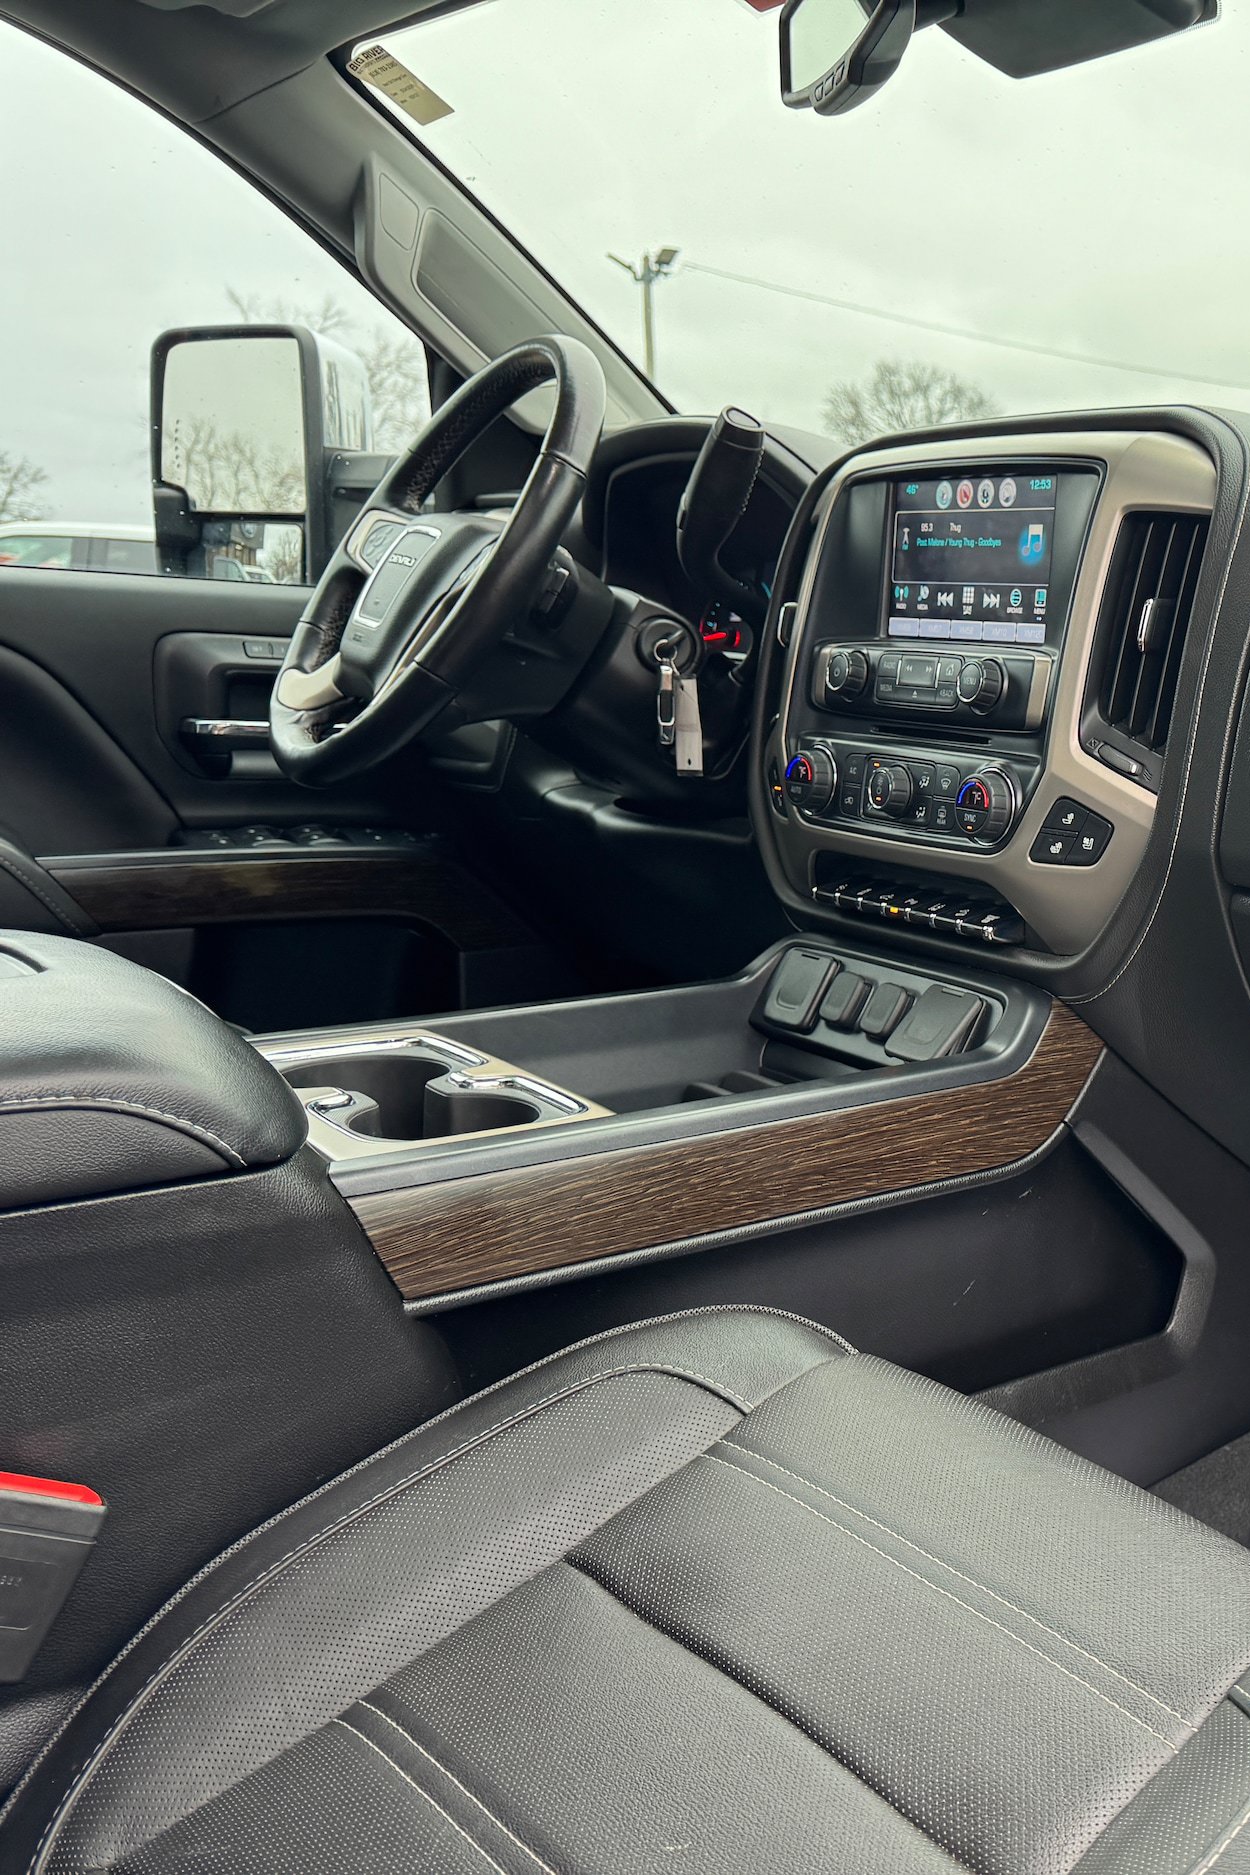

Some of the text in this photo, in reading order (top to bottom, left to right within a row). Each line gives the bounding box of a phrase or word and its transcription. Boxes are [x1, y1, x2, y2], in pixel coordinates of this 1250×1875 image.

[349, 57, 365, 72] BIG
[1029, 479, 1052, 490] 12:53
[920, 522, 934, 532] 95.3
[963, 538, 975, 548] Thug
[963, 813, 977, 823] SYNC
